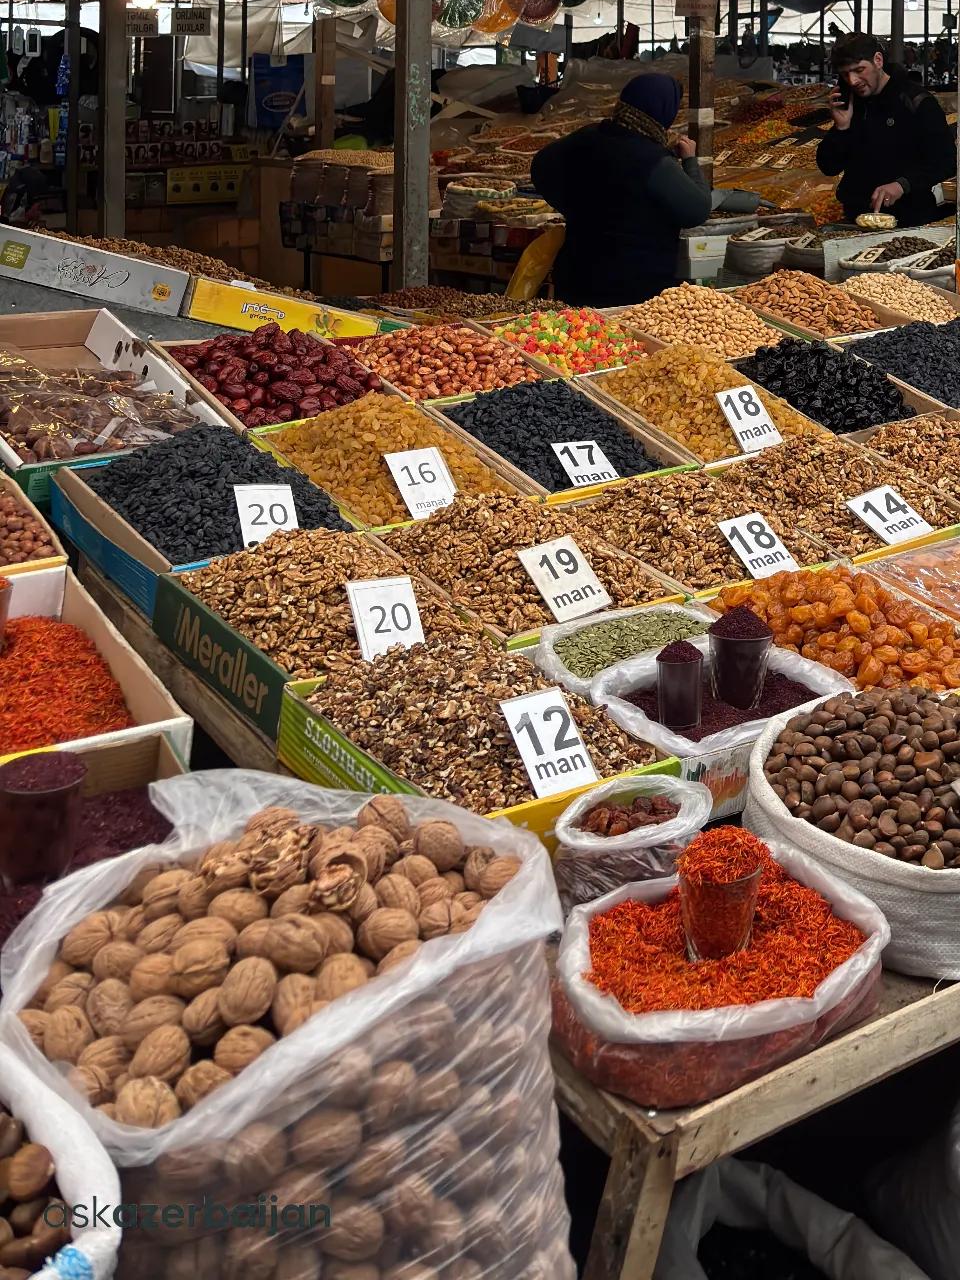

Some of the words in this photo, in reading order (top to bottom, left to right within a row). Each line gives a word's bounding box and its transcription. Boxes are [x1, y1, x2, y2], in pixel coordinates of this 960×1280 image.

[863, 249, 878, 259] 6
[915, 256, 931, 267] 8
[724, 390, 761, 421] 18
[738, 422, 776, 442] man.
[559, 444, 595, 468] 17
[400, 462, 437, 487] 16
[573, 470, 619, 484] man.
[247, 503, 289, 526] 20
[416, 498, 449, 510] manat
[862, 492, 910, 523] 14
[884, 515, 923, 535] man.
[728, 520, 777, 556] 18
[538, 548, 580, 581] 19
[748, 549, 790, 571] man.
[552, 583, 602, 609] man.
[369, 602, 412, 634] 20
[176, 606, 269, 715] Meraller
[514, 705, 581, 757] 12
[534, 753, 587, 780] man
